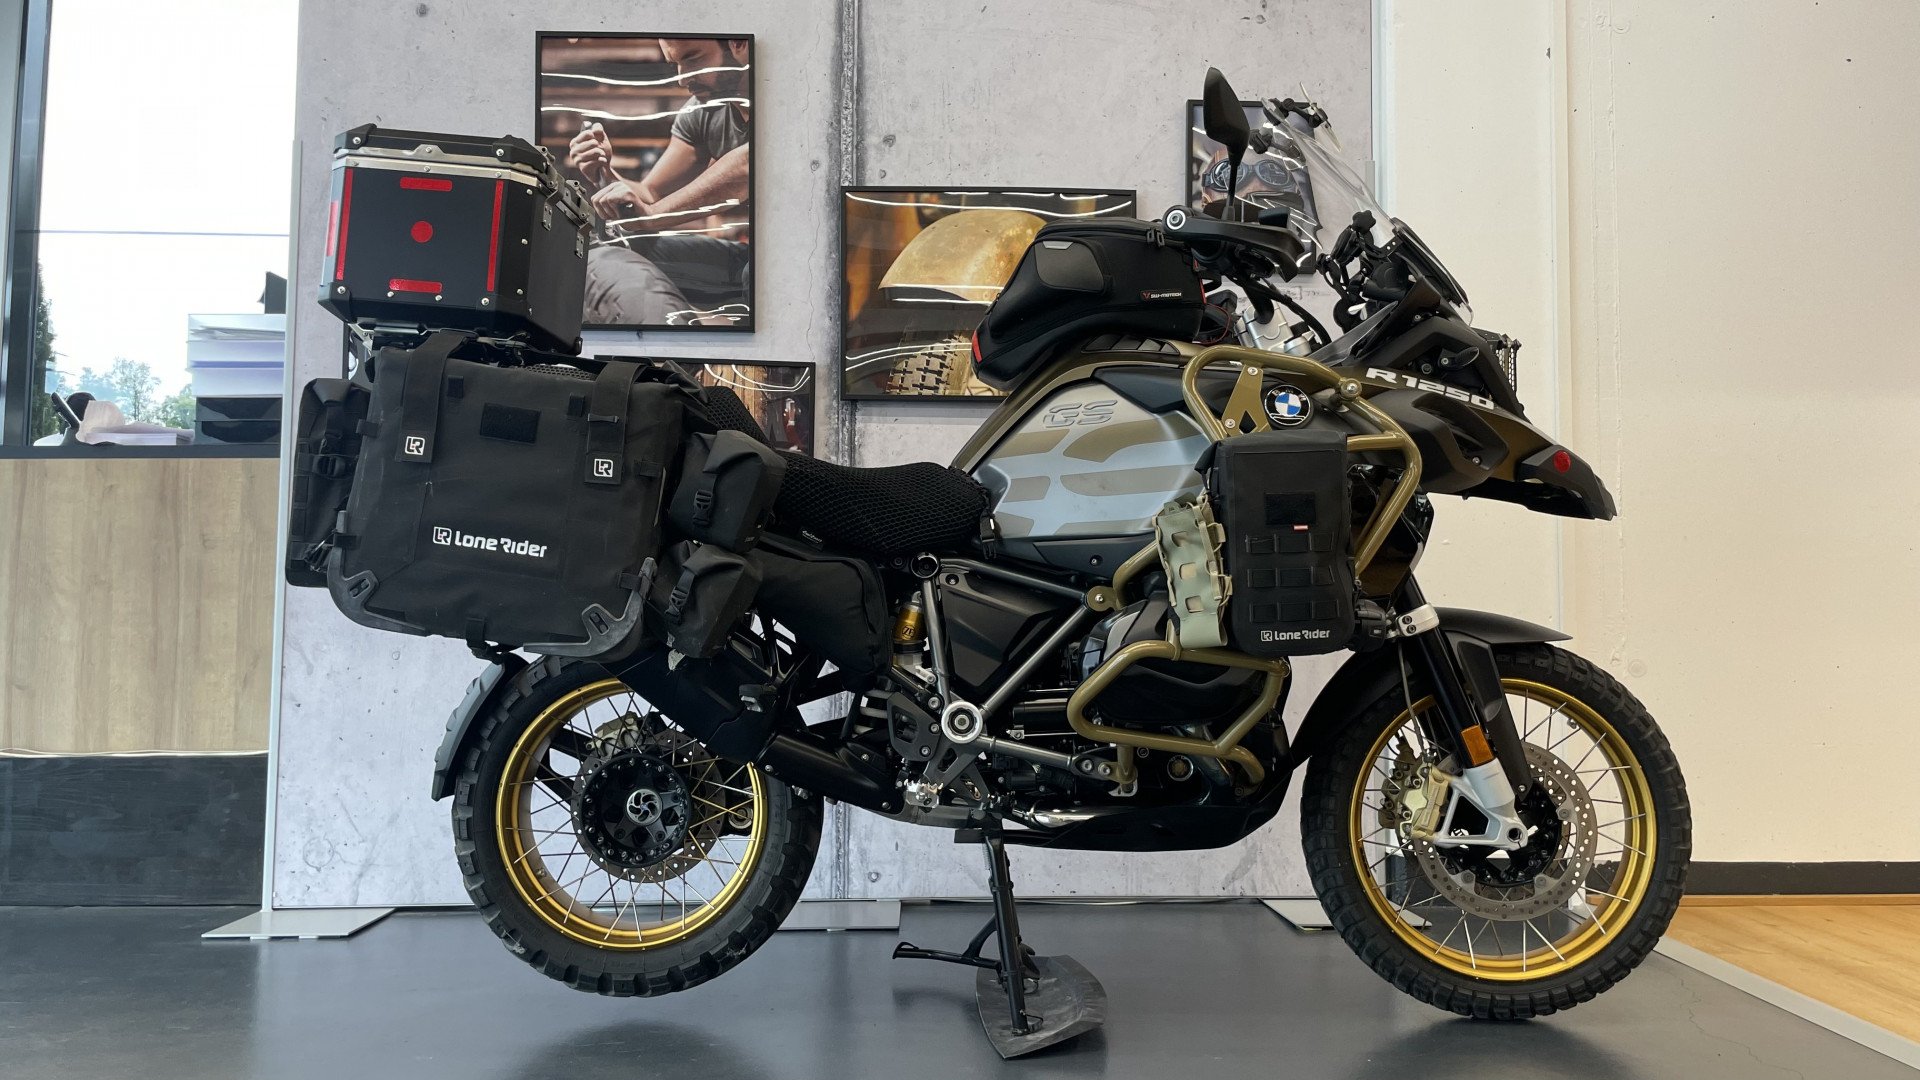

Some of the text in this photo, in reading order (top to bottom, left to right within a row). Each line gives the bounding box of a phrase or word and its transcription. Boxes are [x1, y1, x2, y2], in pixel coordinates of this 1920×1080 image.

[1365, 367, 1495, 410] R 1250
[1042, 400, 1118, 429] GS
[454, 530, 498, 552] Lone
[500, 537, 548, 558] Rider
[1274, 630, 1302, 641] Lone
[1301, 628, 1331, 640] Rider
